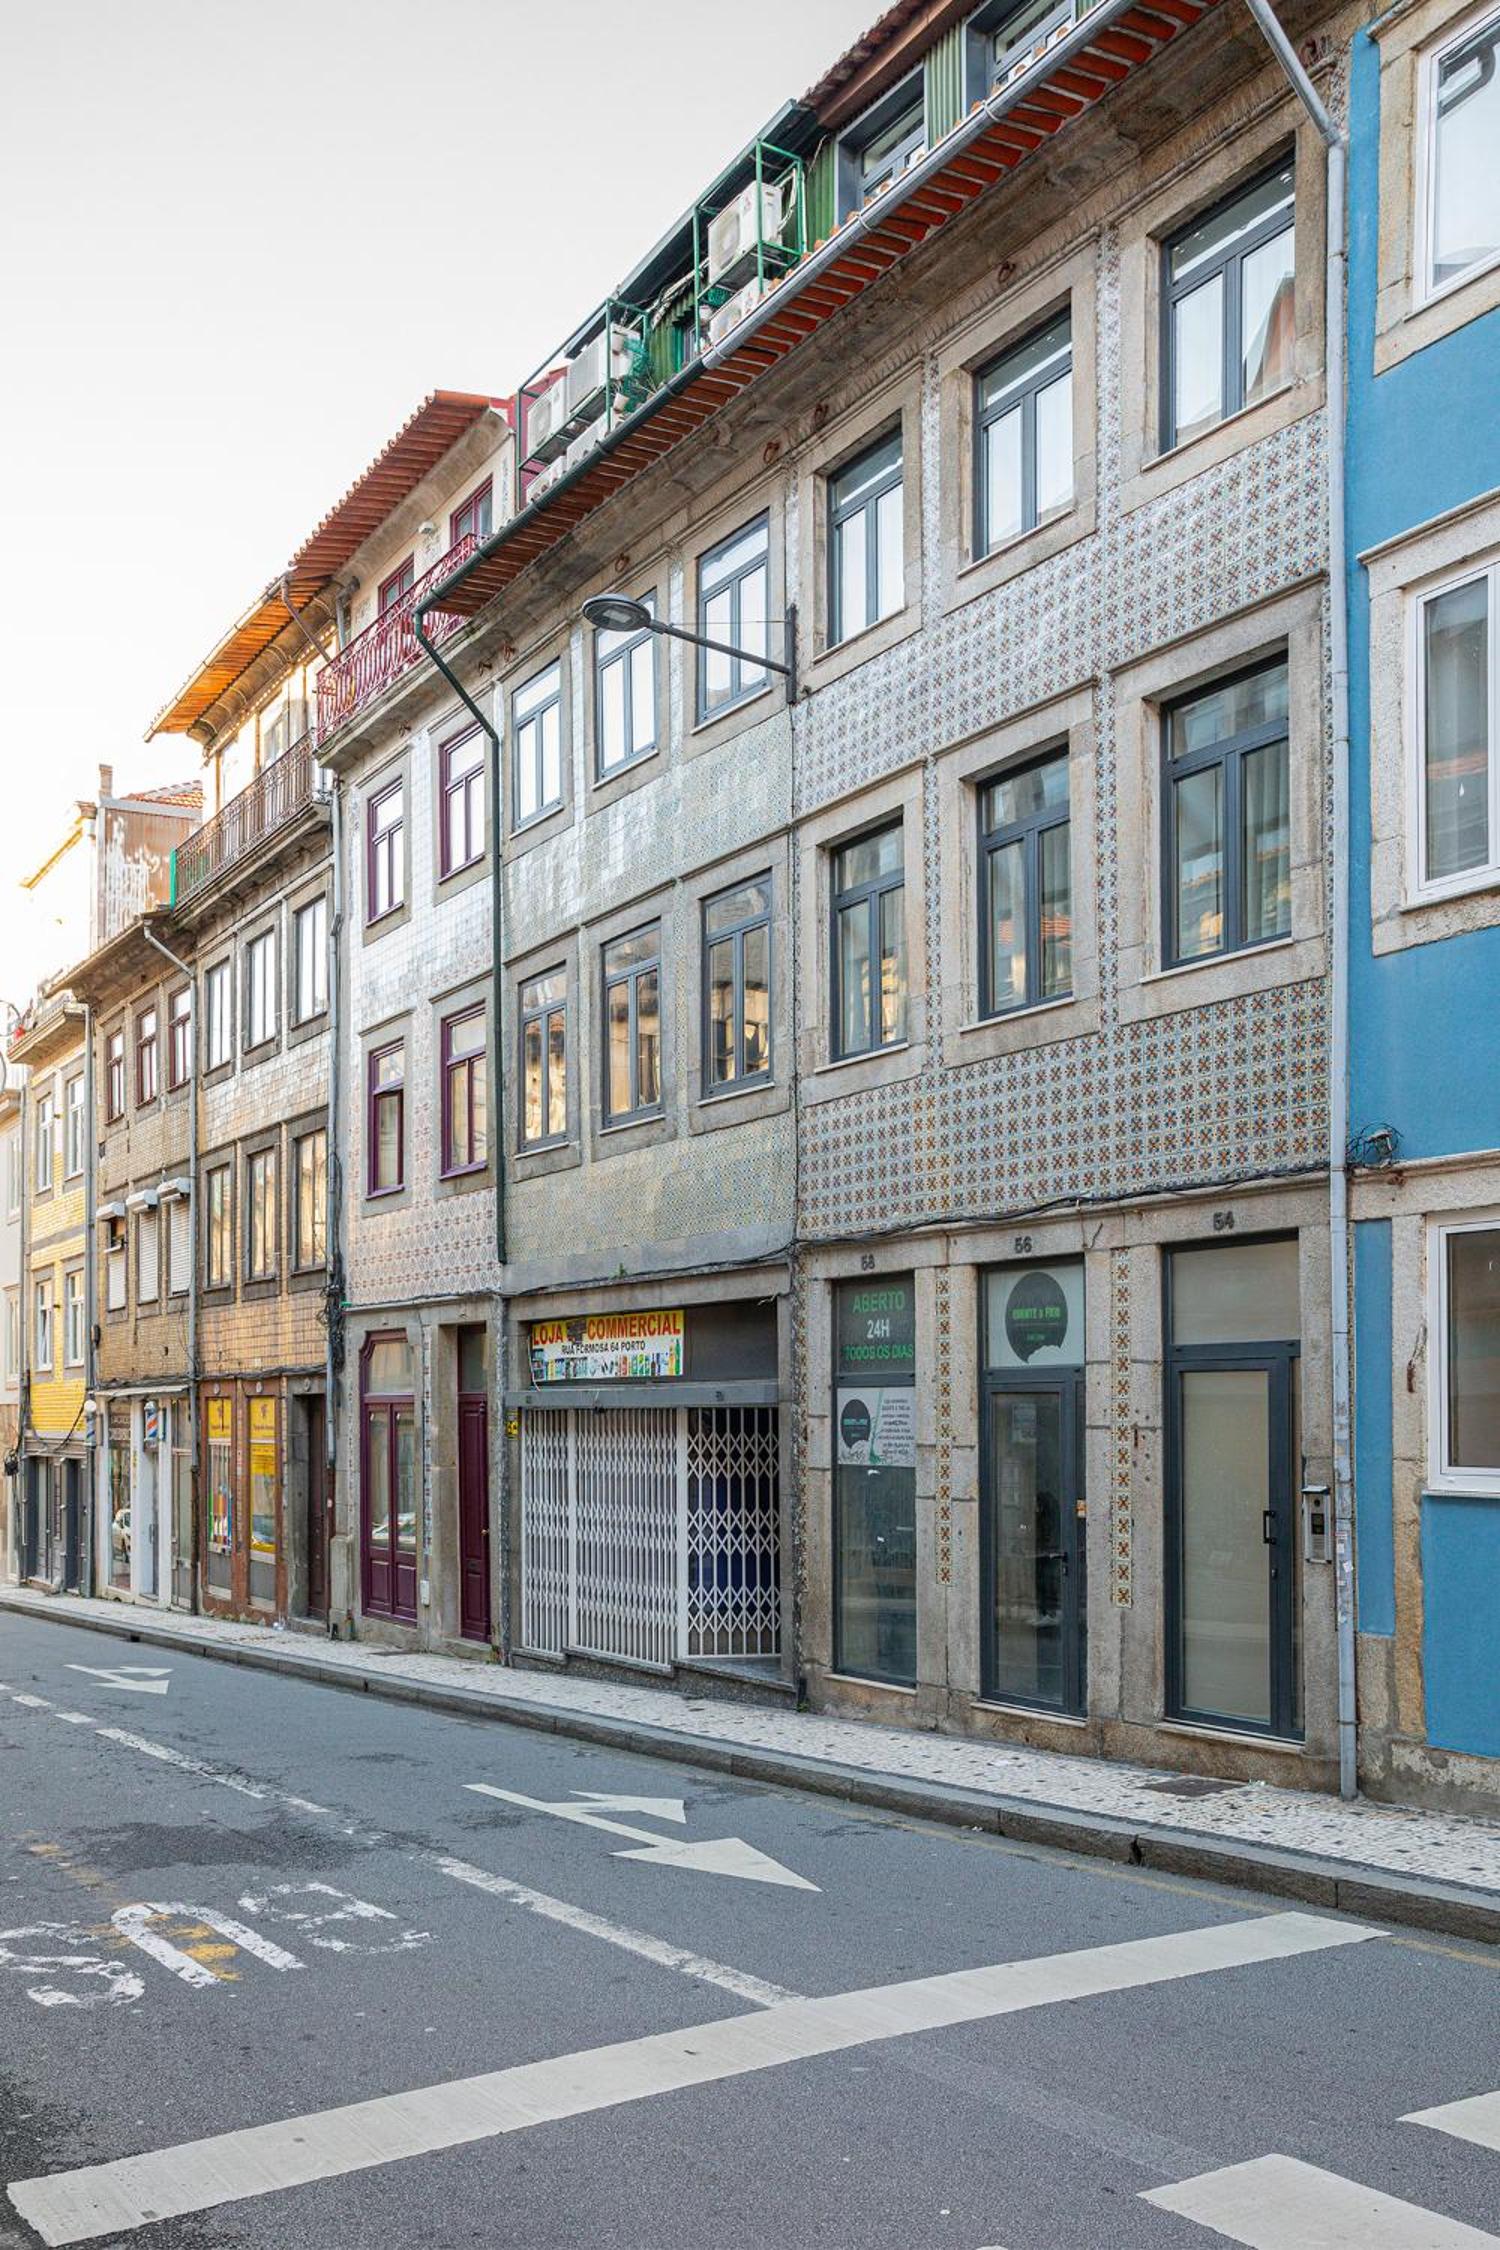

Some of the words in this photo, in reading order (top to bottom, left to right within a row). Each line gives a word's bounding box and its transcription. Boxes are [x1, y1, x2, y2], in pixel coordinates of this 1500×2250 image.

[1213, 1211, 1235, 1229] 54
[1014, 1237, 1033, 1252] 56
[852, 1291, 905, 1313] ABERTO
[532, 1323, 563, 1345] LOJA
[587, 1313, 681, 1340] COMMERCIAL
[866, 1318, 890, 1338] 24H
[576, 1342, 608, 1354] FORMOSA
[621, 1340, 646, 1351] PORTO
